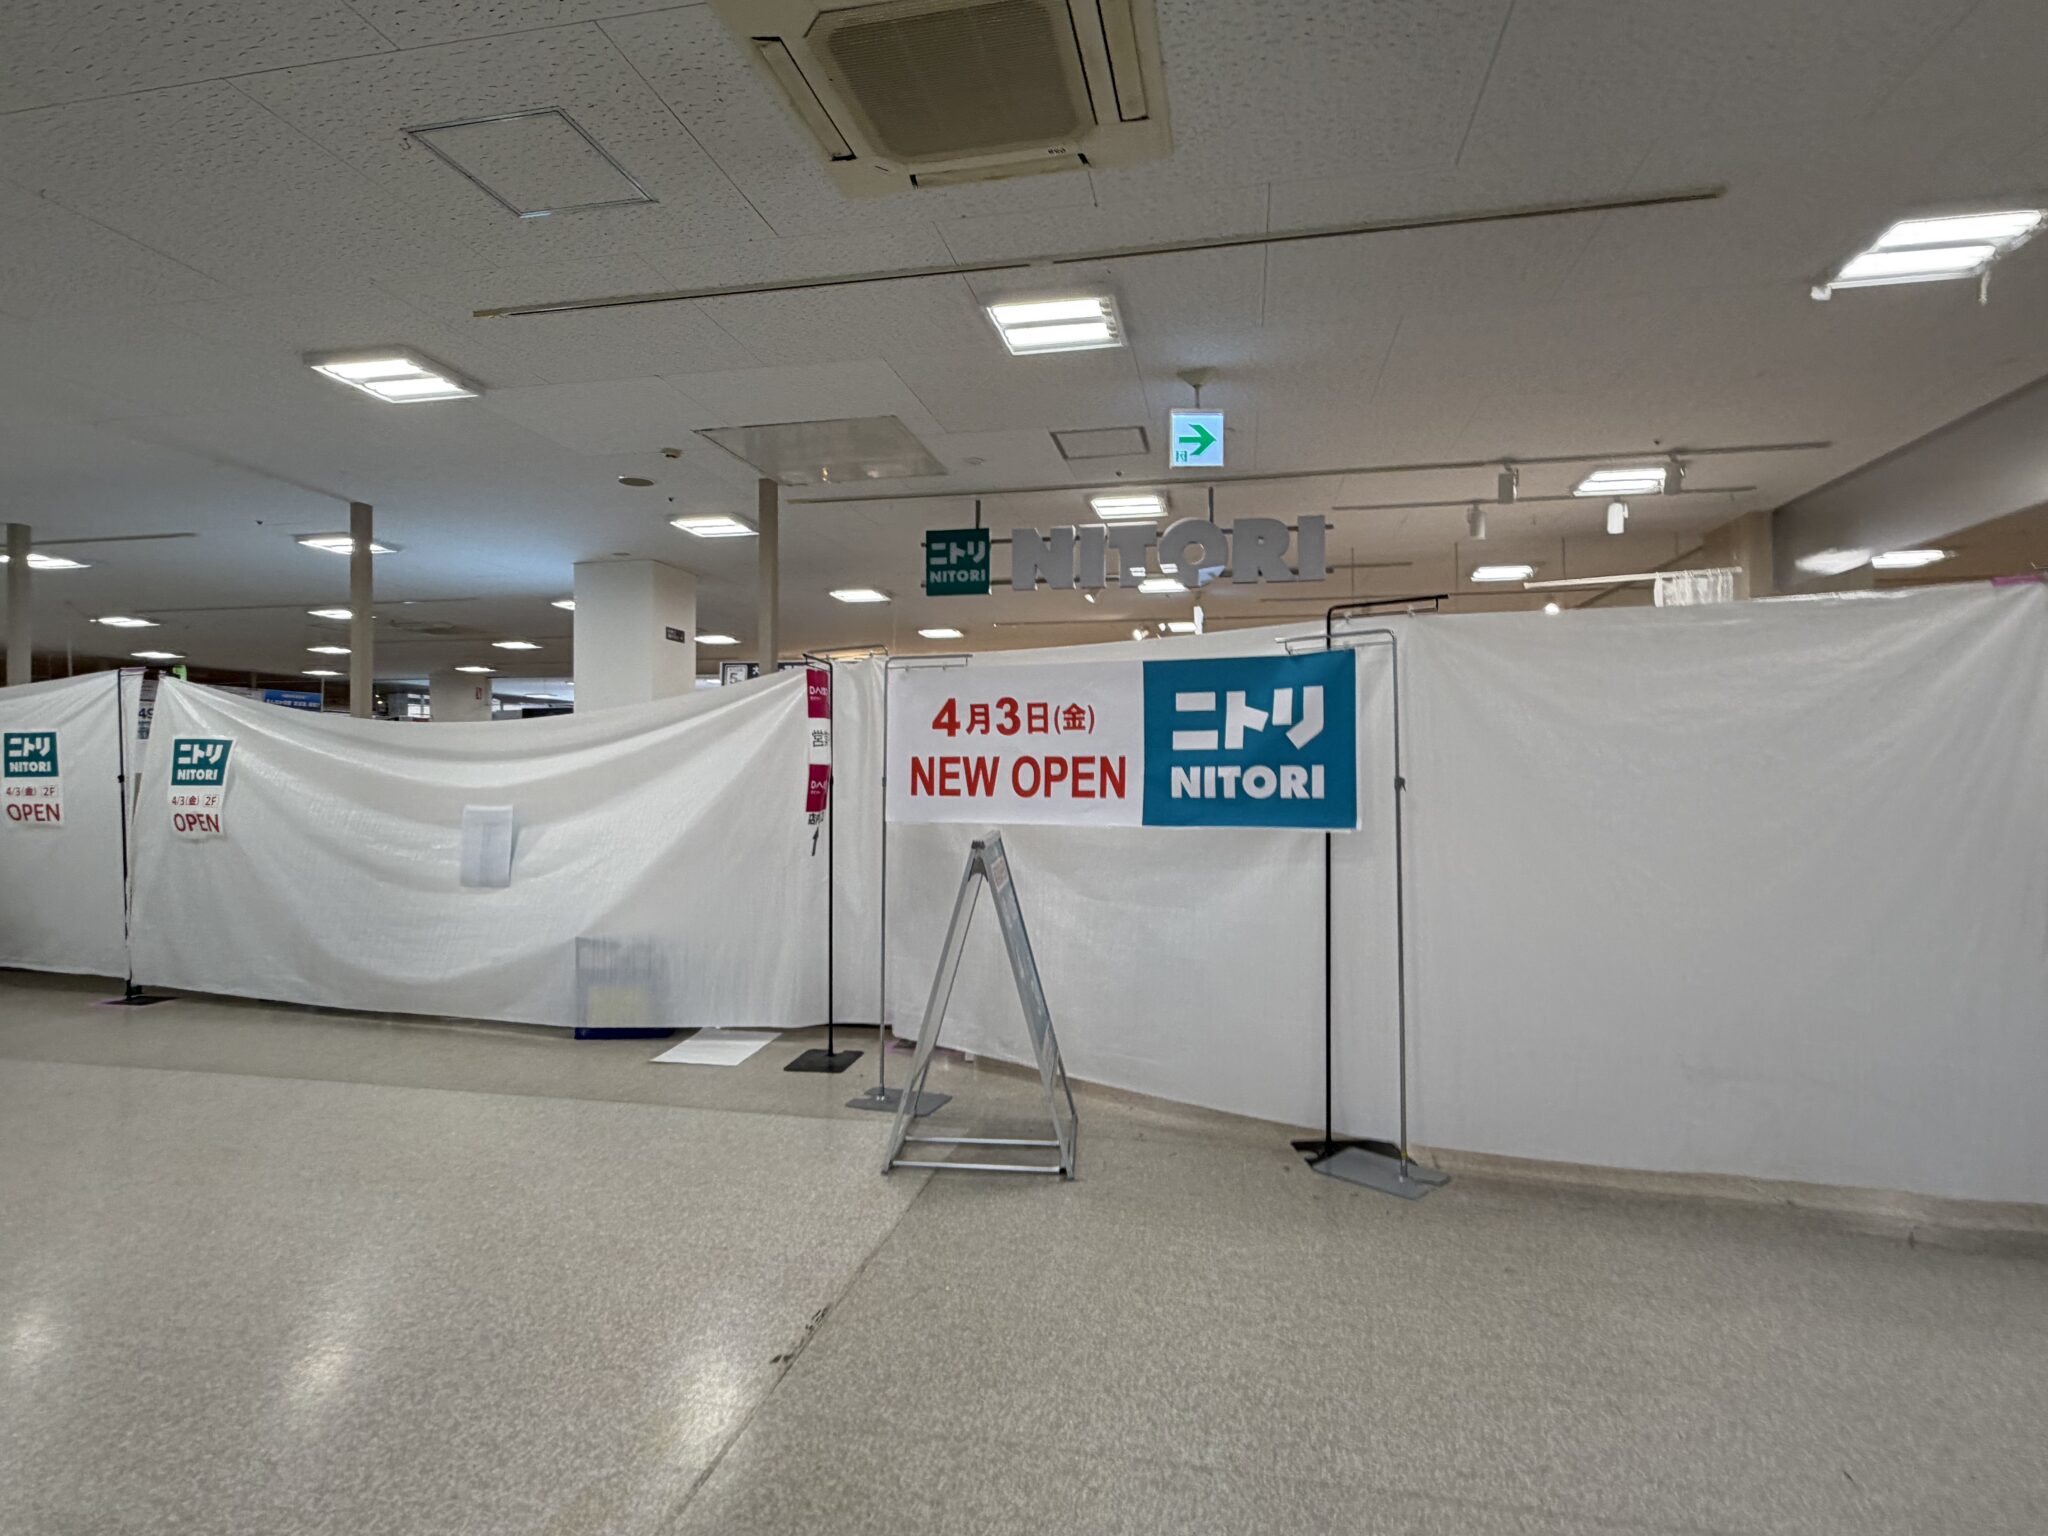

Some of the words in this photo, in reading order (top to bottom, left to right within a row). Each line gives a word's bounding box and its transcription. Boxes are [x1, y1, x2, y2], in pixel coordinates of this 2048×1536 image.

[929, 541, 986, 565] ニトリ
[1012, 515, 1326, 591] NITORI
[929, 569, 986, 583] NITORI
[932, 697, 1095, 737] 4月3日(金)
[1172, 685, 1325, 751] ニトリ
[8, 737, 51, 757] ニトリ
[178, 744, 224, 765] ニトリ
[9, 761, 52, 773] NITORI
[177, 769, 219, 781] NITORI
[910, 756, 1000, 798] NEW
[1012, 755, 1126, 799] OPEN
[1171, 764, 1325, 799] NITORI
[43, 787, 56, 797] 2F
[204, 796, 217, 806] 2F
[6, 803, 61, 822] OPEN
[173, 813, 220, 832] OPEN
